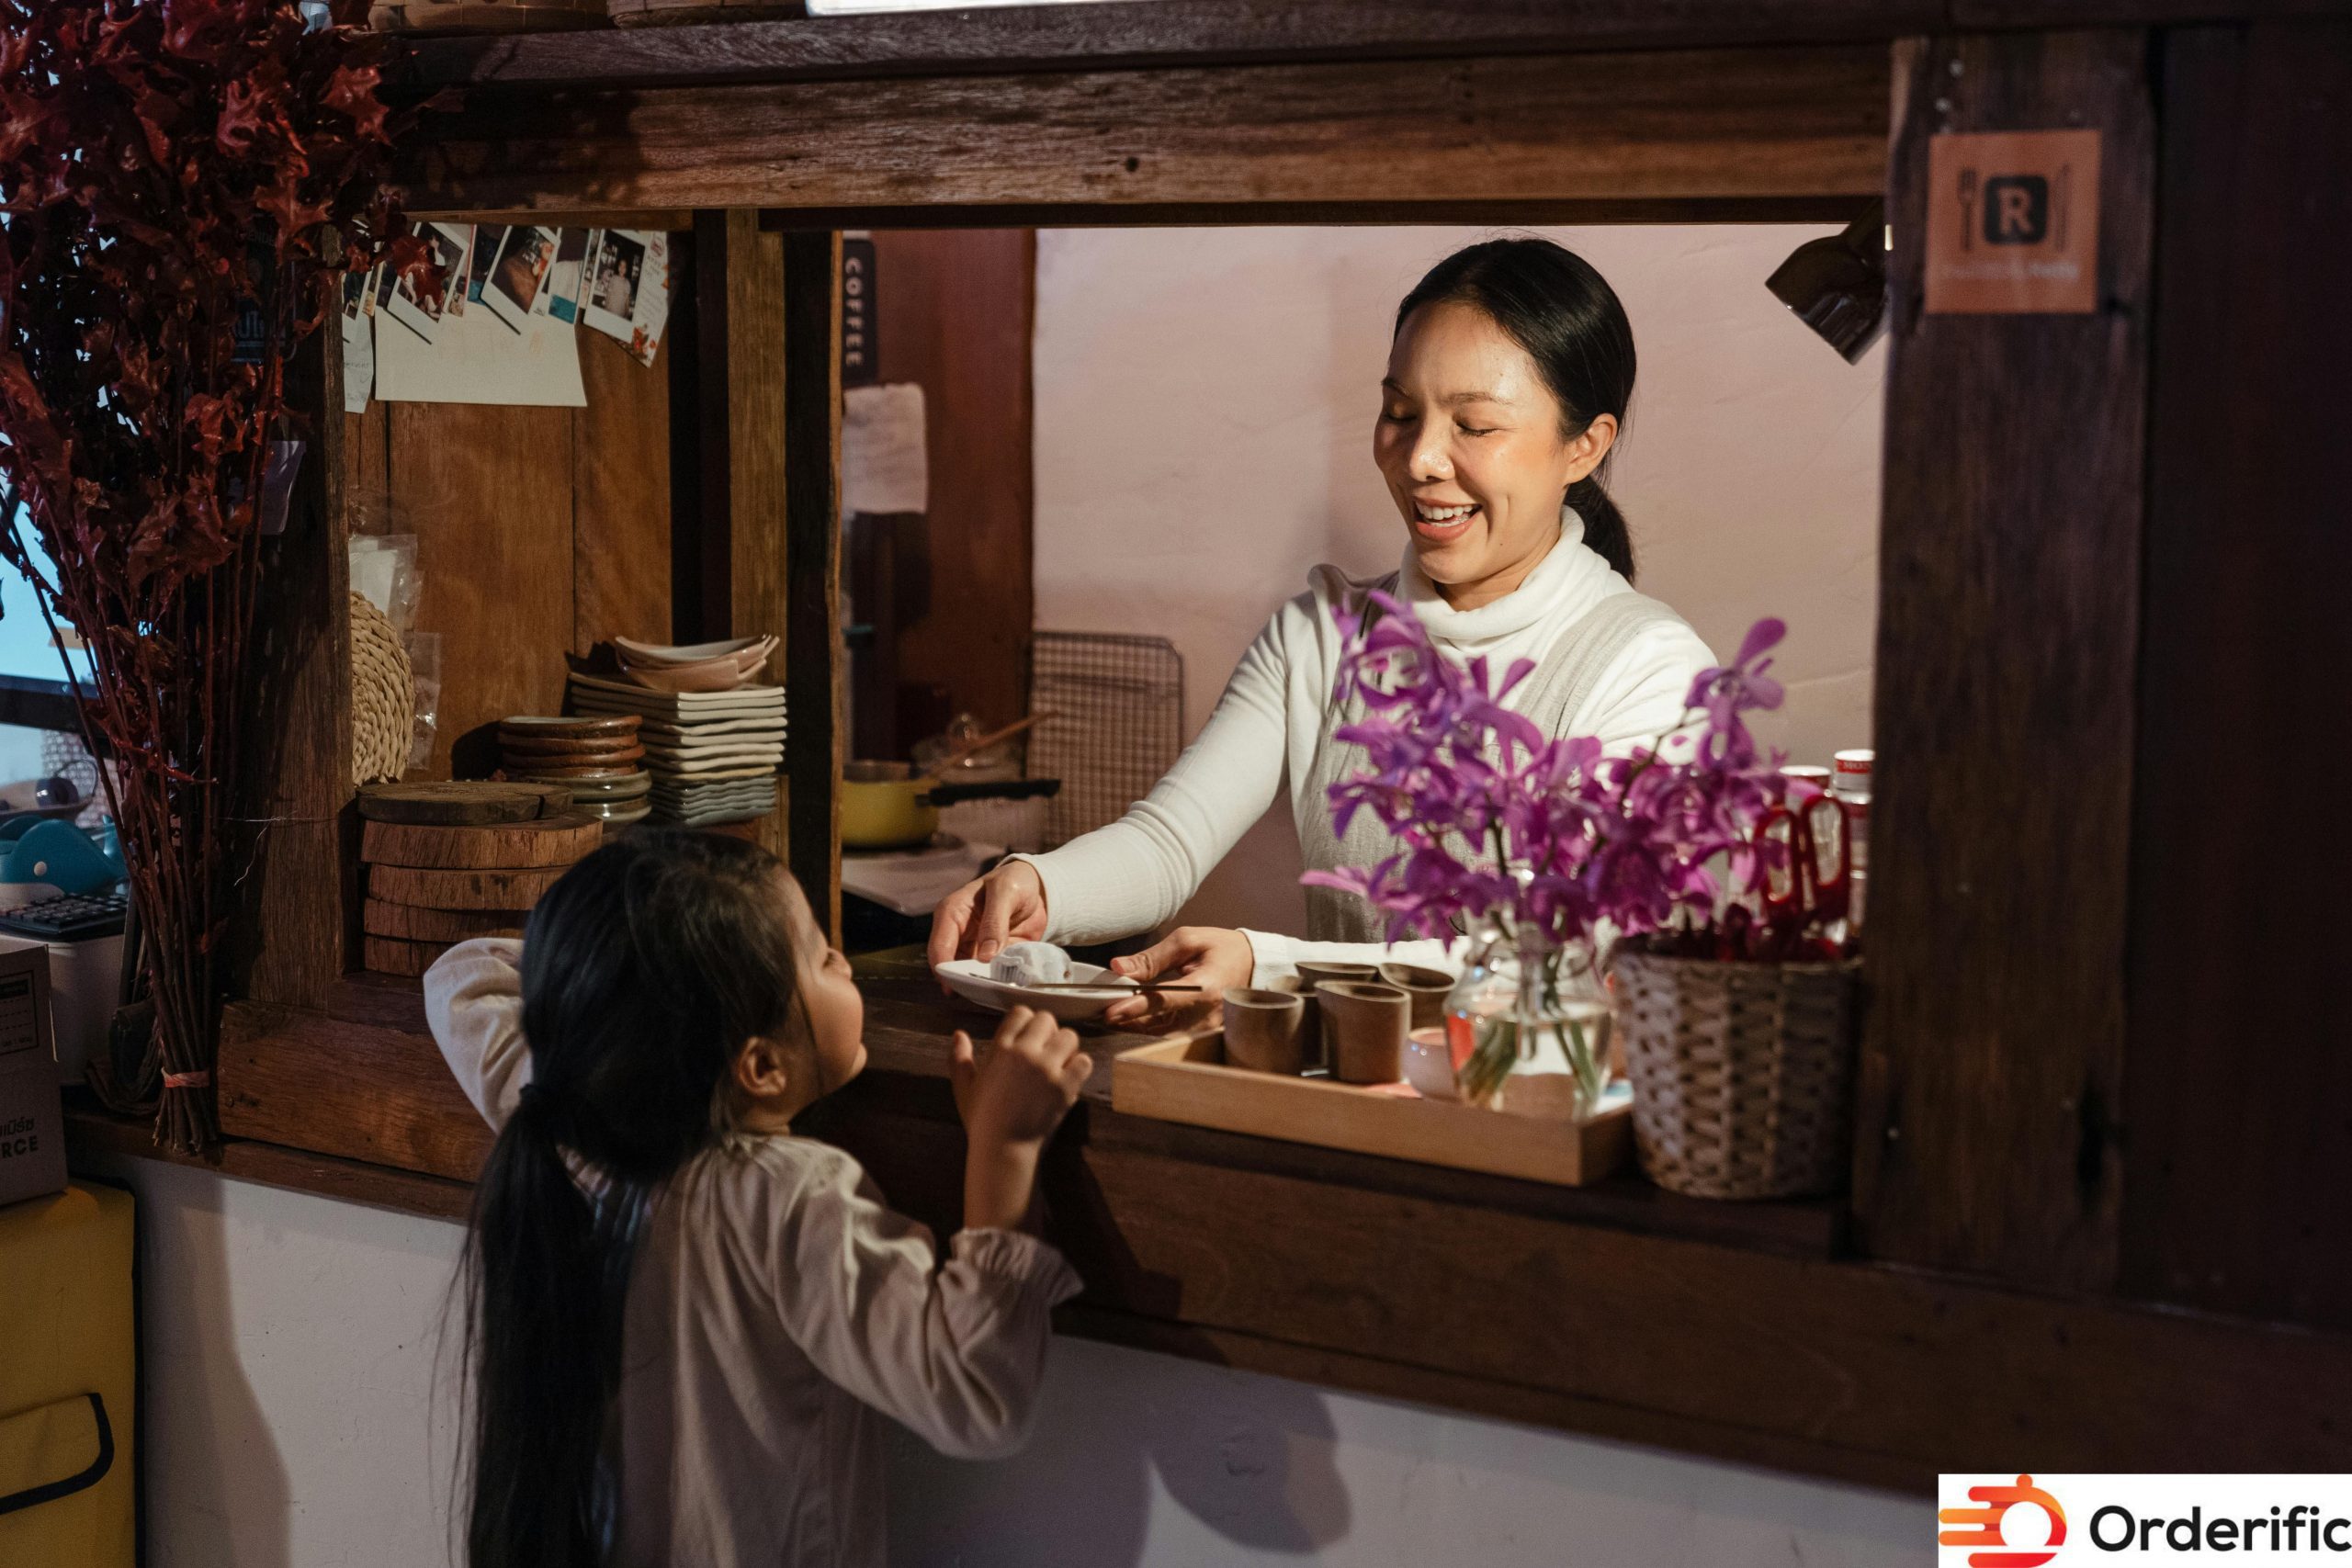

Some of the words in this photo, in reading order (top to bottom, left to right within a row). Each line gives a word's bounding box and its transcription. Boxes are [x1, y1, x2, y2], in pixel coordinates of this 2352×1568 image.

[1997, 186, 2033, 235] R
[845, 256, 864, 367] COFFEE
[2, 1135, 39, 1158] RCE
